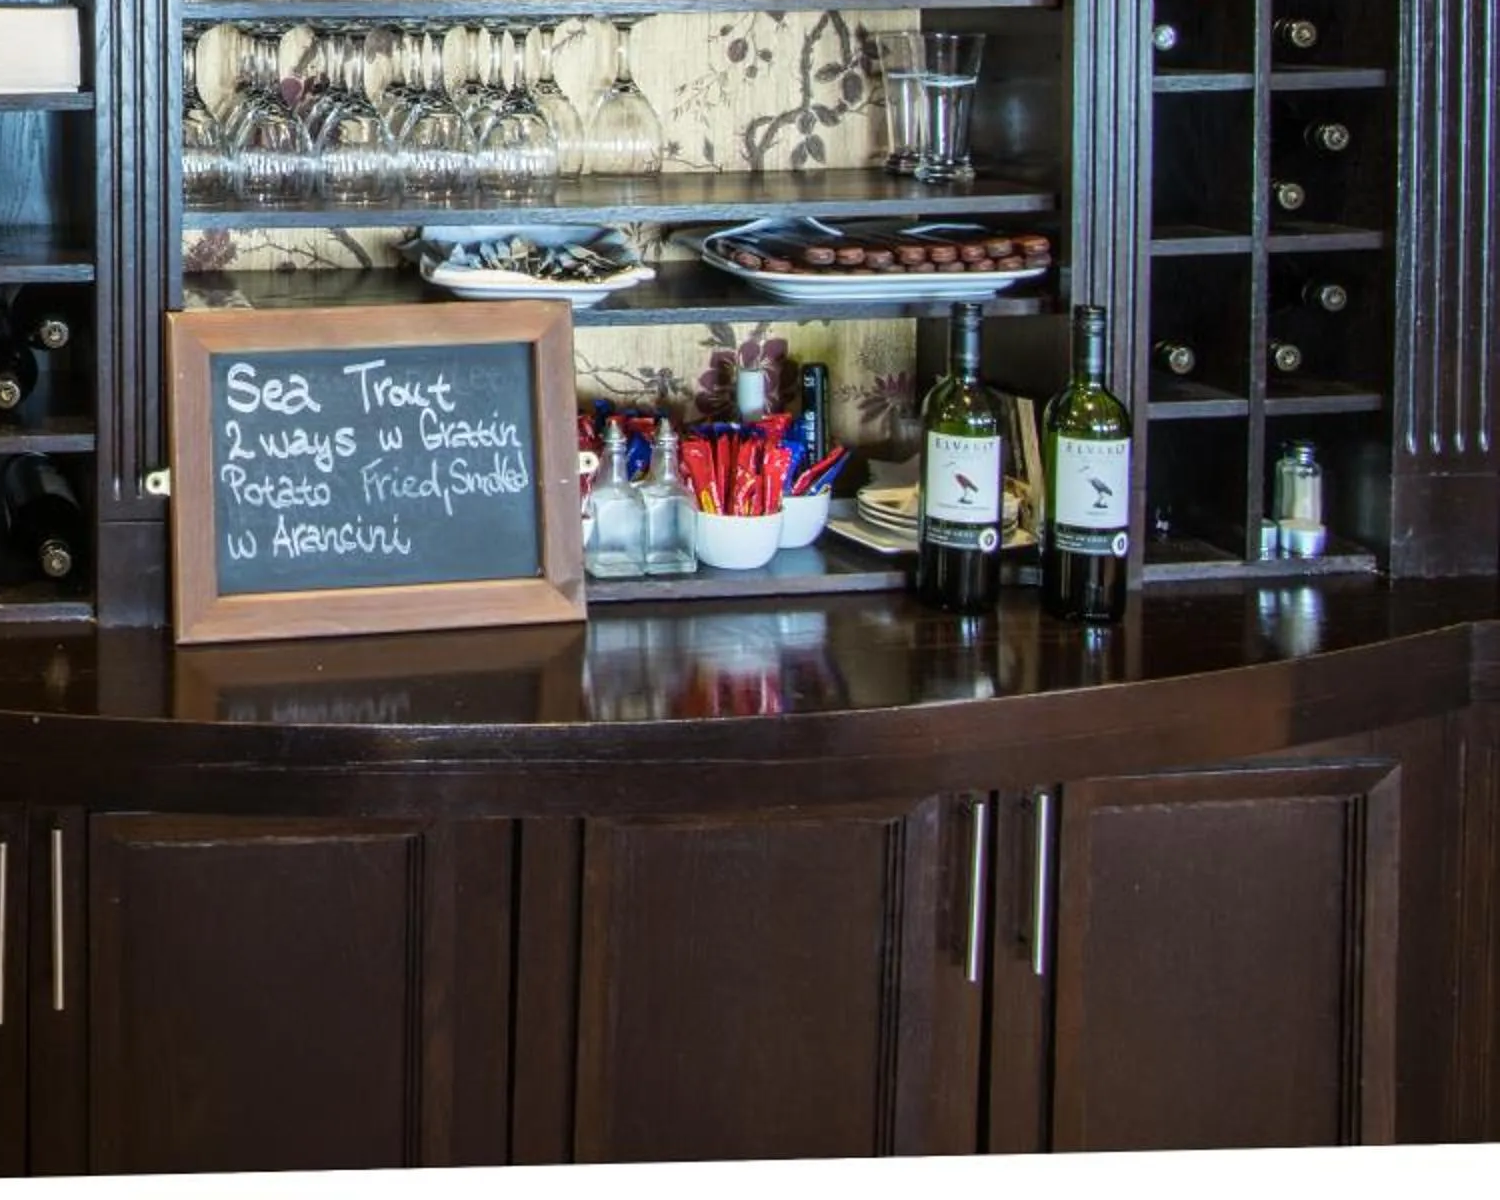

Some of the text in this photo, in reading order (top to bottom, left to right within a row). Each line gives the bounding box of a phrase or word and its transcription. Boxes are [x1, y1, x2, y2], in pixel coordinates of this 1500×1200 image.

[226, 359, 456, 415] Sea Trout
[419, 407, 523, 450] Gratin
[221, 463, 332, 510] Potato
[273, 514, 412, 560] Arancini
